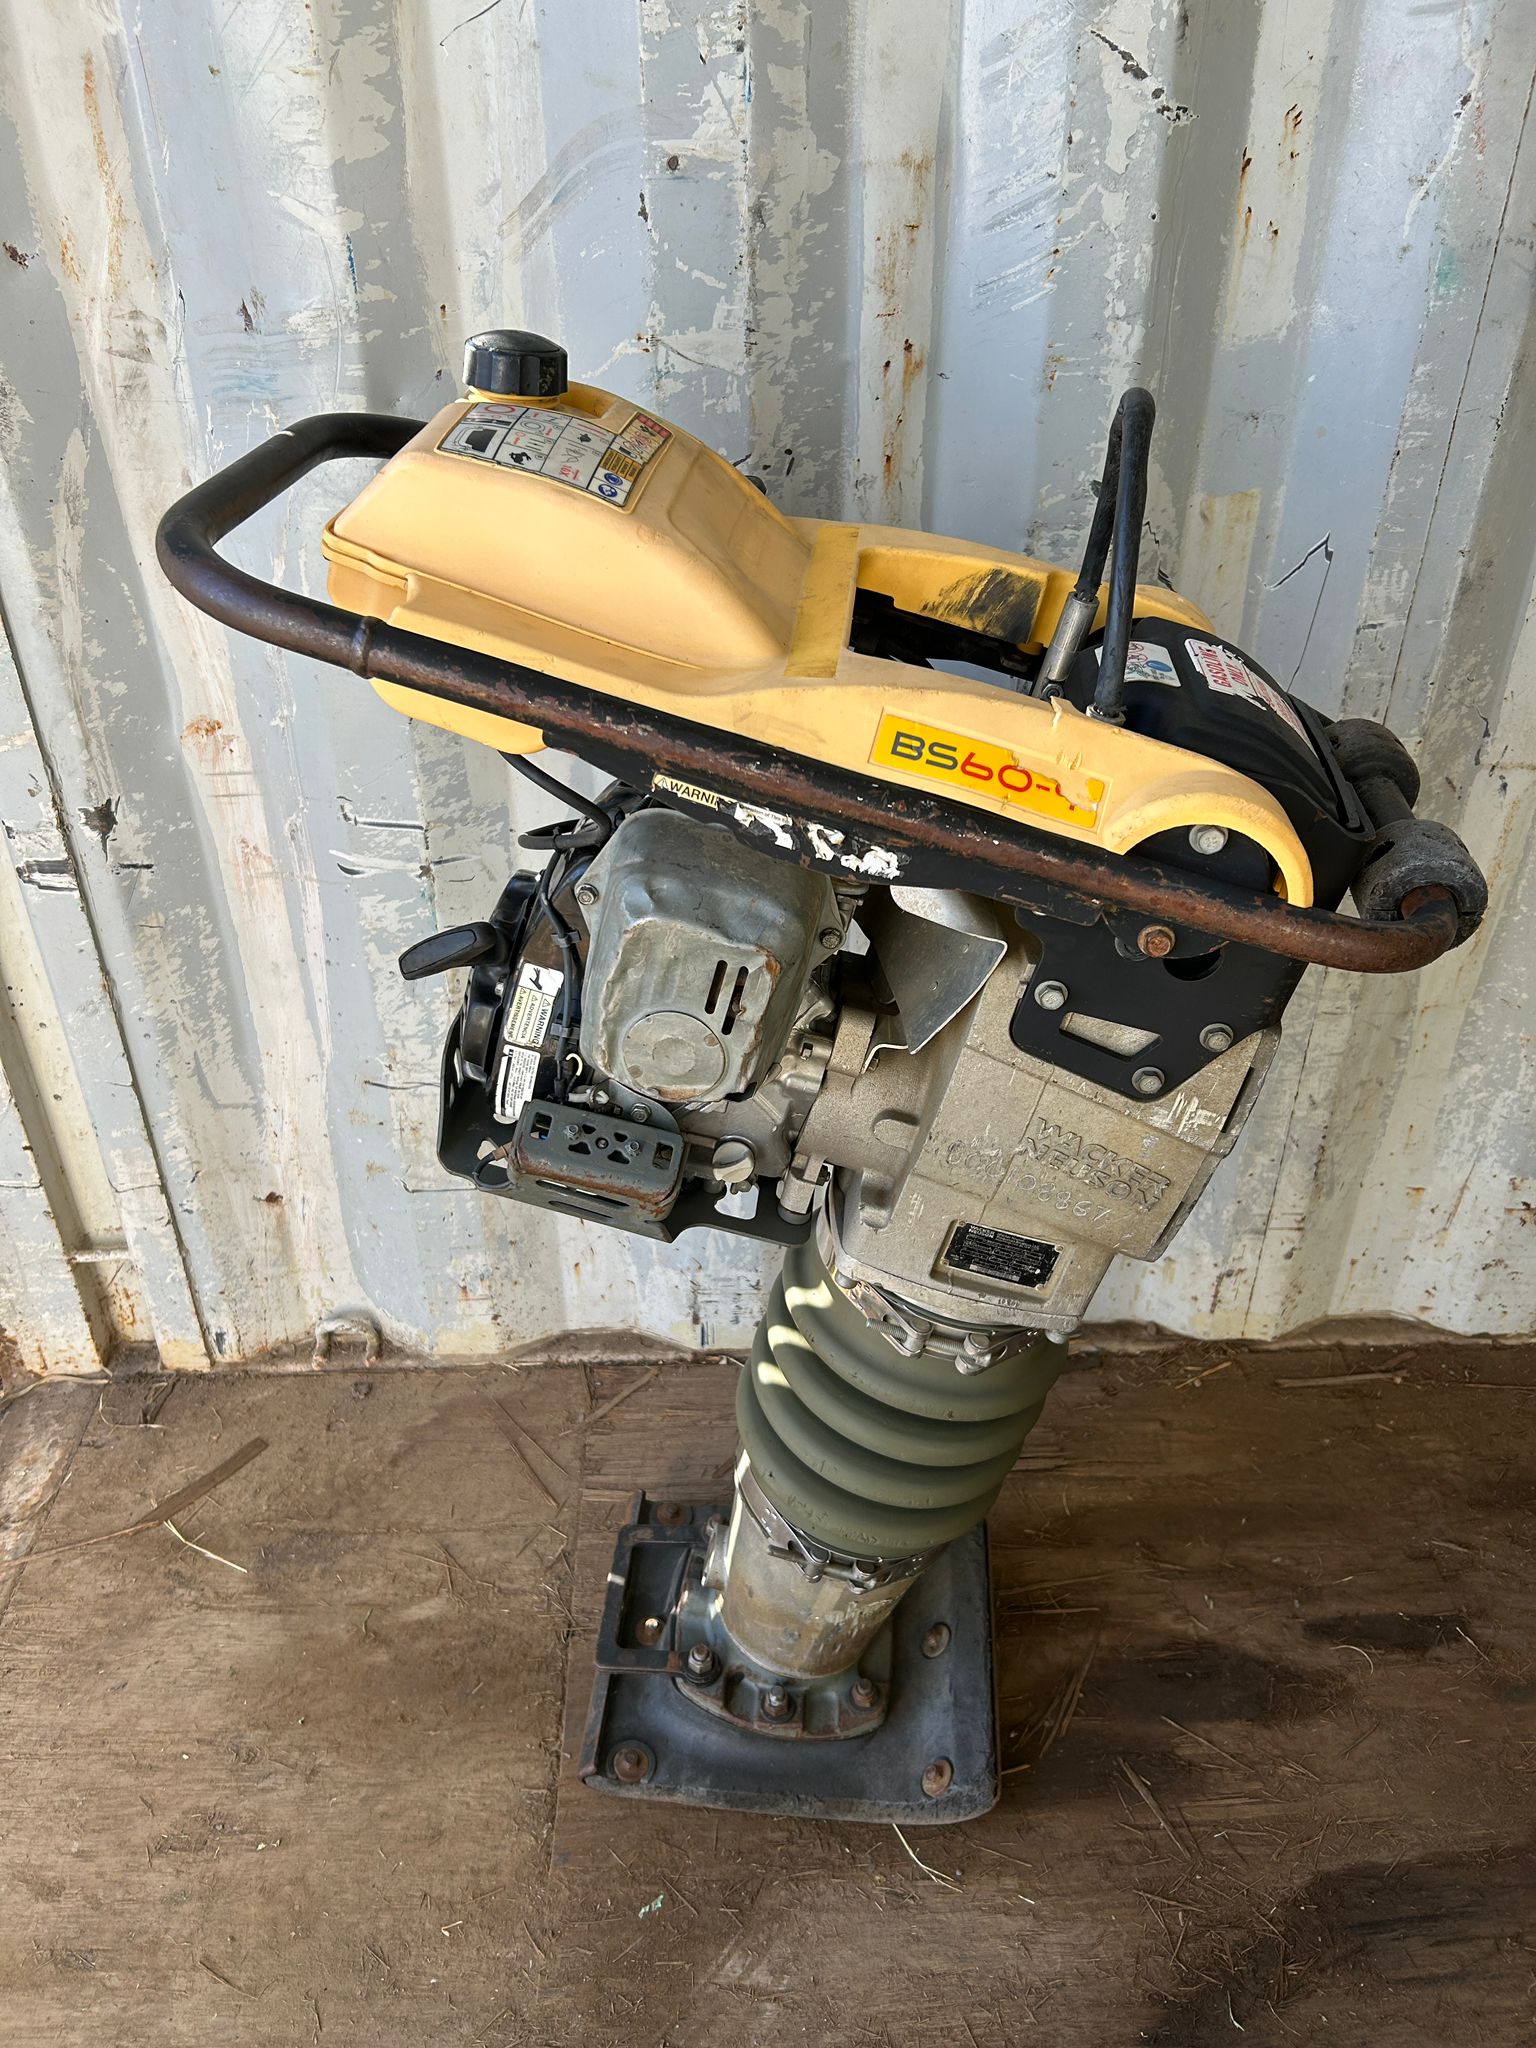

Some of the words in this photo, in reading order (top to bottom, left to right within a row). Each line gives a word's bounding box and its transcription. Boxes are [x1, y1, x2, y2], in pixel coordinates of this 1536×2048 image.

[520, 1003, 536, 1038] ADVERTENCIA
[532, 1008, 549, 1044] WARNING
[1015, 1137, 1163, 1212] NEUSON
[1037, 1117, 1172, 1197] WACKER
